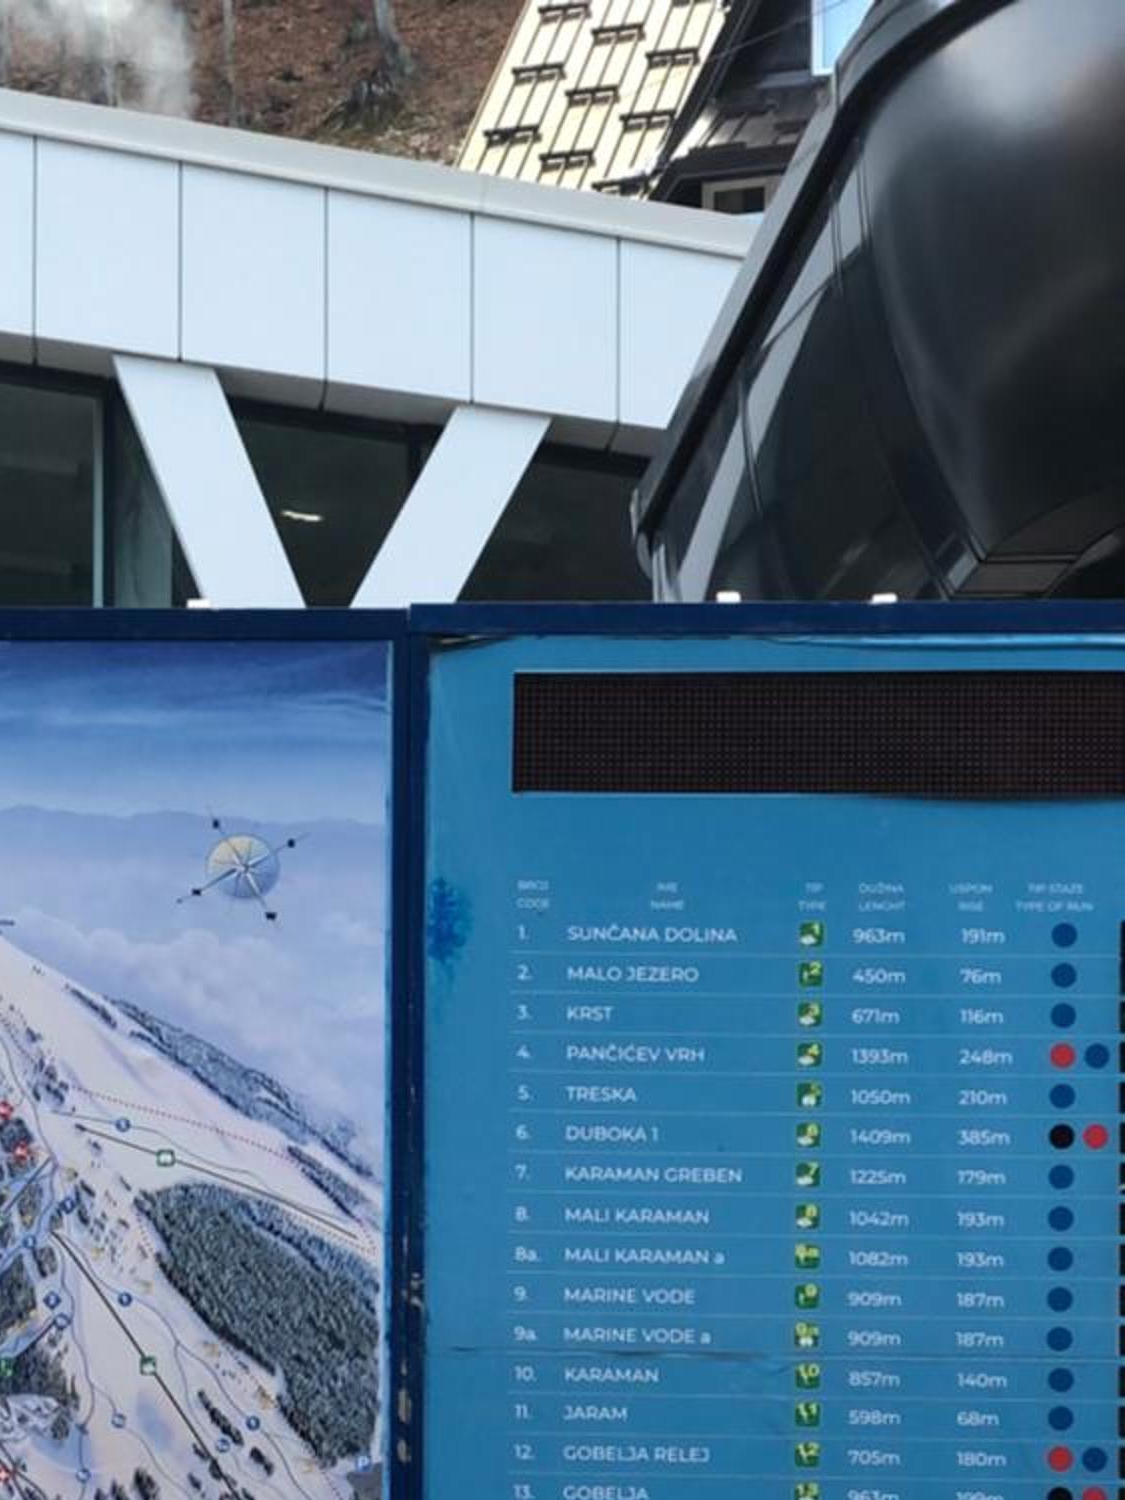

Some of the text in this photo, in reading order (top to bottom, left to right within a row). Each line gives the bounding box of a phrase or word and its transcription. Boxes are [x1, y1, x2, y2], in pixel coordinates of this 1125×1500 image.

[568, 924, 737, 942] SUNČANA DOLINA
[853, 928, 905, 943] 963m
[963, 928, 1005, 944] 191m
[568, 966, 699, 982] MALO JEZERO
[853, 968, 905, 984] 450m
[961, 968, 1001, 984] 76m
[567, 1006, 613, 1021] KRST
[851, 1008, 899, 1024] 671m
[961, 1009, 1003, 1024] 116m
[665, 1048, 704, 1061] VRH
[853, 1049, 907, 1064] 1393m
[961, 1050, 1012, 1064] 248m
[566, 1086, 637, 1102] TRESKA
[851, 1090, 910, 1104] 1050m
[959, 1090, 1007, 1104] 210m
[565, 1126, 647, 1142] DUBOKA
[851, 1130, 910, 1144] 1409m
[960, 1130, 1009, 1145] 385m
[565, 1166, 741, 1183] KARAMAN GREBEN
[851, 1170, 906, 1184] 1225m
[958, 1170, 1005, 1184] 179m
[565, 1208, 709, 1223] MALI KARAMAN
[851, 1211, 909, 1226] 1042m
[957, 1212, 1003, 1227] 193m
[565, 1248, 609, 1262] MALI
[615, 1249, 709, 1264] KARAMAN
[849, 1252, 908, 1266] 1082m
[958, 1252, 1003, 1267] 193m
[564, 1288, 693, 1304] MARINE VODE
[848, 1292, 901, 1306] 909m
[957, 1293, 1004, 1307] 187m
[564, 1328, 636, 1342] MARINE
[642, 1328, 694, 1344] VODE
[848, 1331, 901, 1346] 909m
[955, 1332, 1003, 1346] 187m
[565, 1367, 658, 1382] KARAMAN
[849, 1371, 899, 1386] 857m
[957, 1373, 1007, 1387] 140m
[564, 1406, 627, 1420] JARAM
[849, 1409, 899, 1424] 598m
[957, 1412, 999, 1426] 68m
[563, 1446, 709, 1462] GOBELJA RELEJ
[848, 1450, 899, 1465] 705m
[957, 1452, 1006, 1466] 180m
[563, 1485, 649, 1500] GOBELJA
